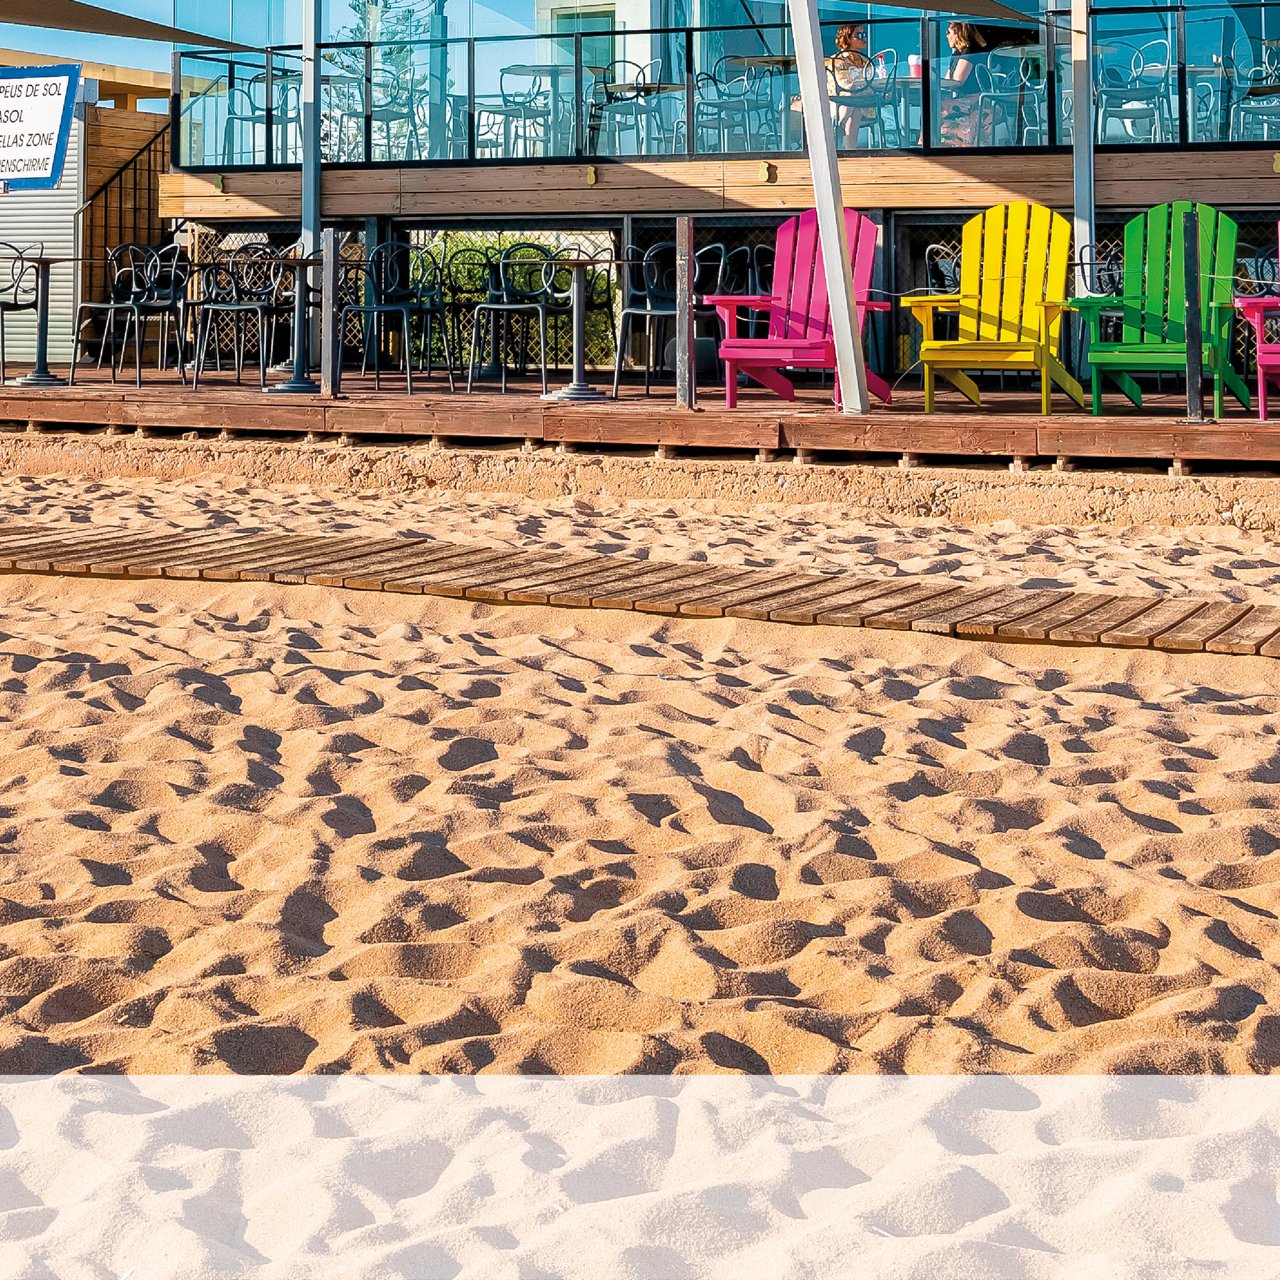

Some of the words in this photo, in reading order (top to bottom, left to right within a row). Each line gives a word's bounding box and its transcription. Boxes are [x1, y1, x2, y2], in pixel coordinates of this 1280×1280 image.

[25, 84, 40, 98] DE
[42, 83, 62, 97] SOL
[26, 132, 55, 147] ZONE
